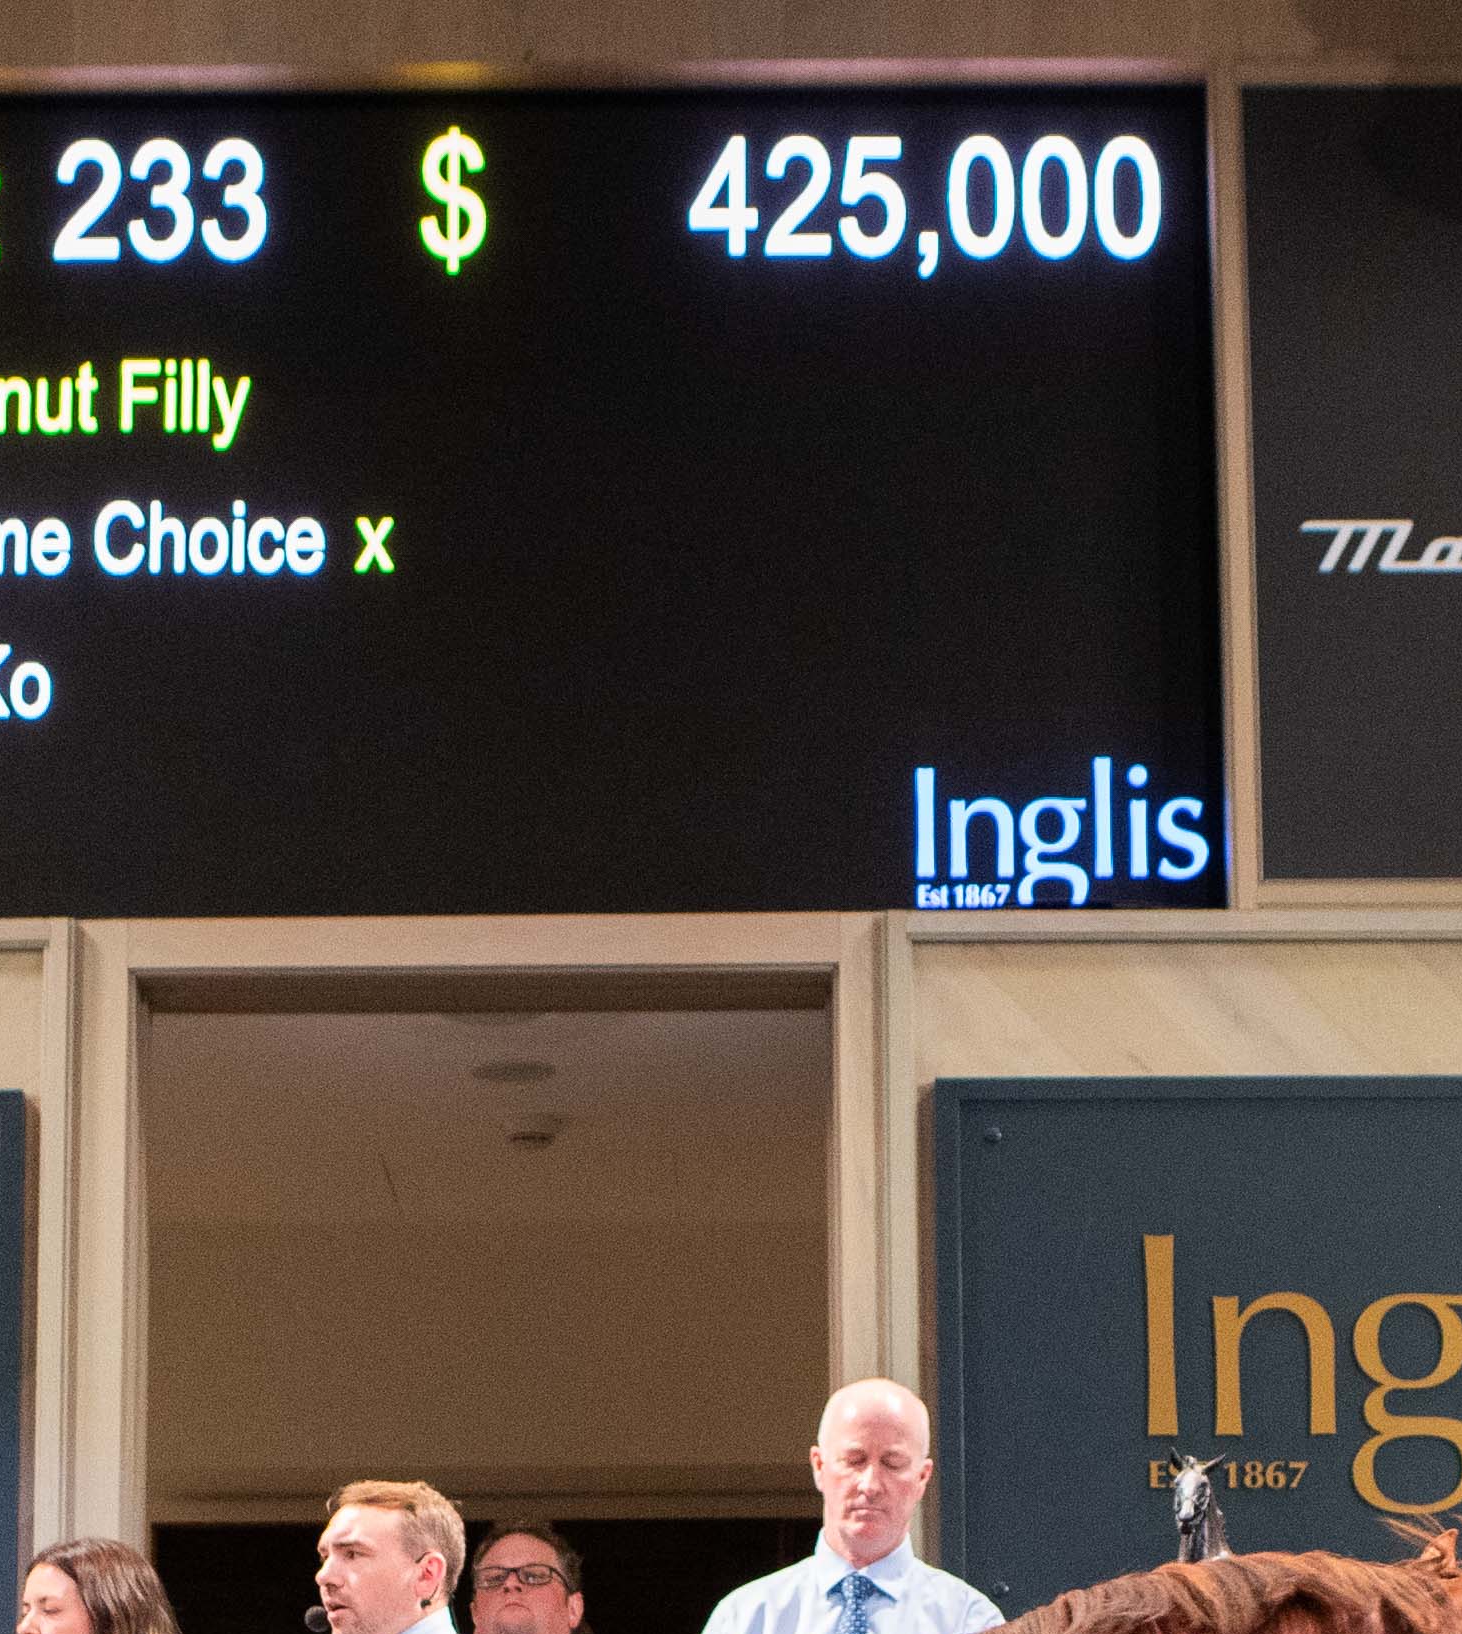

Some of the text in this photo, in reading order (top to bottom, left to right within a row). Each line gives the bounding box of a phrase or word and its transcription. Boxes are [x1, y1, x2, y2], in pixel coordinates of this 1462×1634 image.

[50, 136, 270, 265] 233
[418, 125, 489, 275] $
[686, 132, 1164, 280] 425,000
[118, 357, 252, 452] Filly
[92, 498, 328, 577] Choice
[353, 514, 397, 575] x
[914, 755, 1211, 906] Inglis
[916, 883, 1011, 909] Est 1867
[1225, 1459, 1311, 1490] 1867
